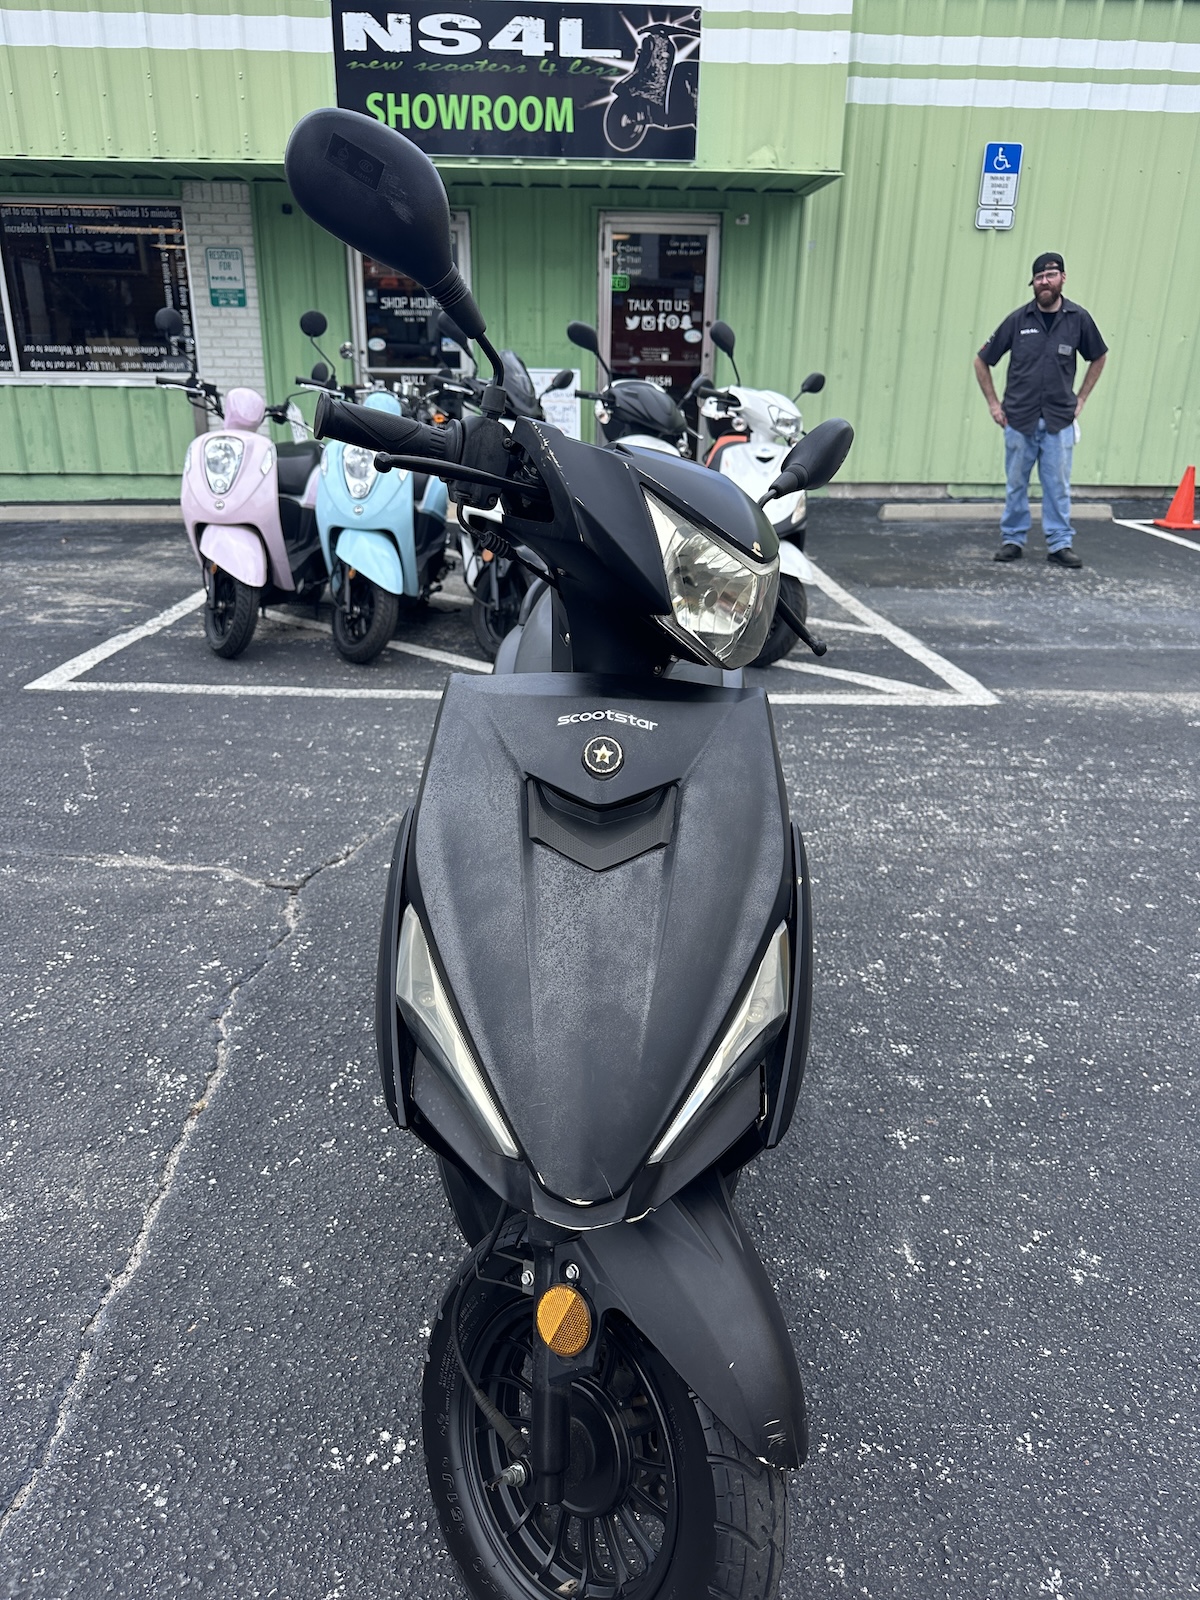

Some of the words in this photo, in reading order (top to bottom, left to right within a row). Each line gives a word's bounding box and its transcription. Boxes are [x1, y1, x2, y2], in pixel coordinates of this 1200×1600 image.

[342, 11, 622, 59] NS4L
[346, 58, 404, 71] new
[413, 58, 528, 75] scooters
[538, 59, 556, 77] 4
[566, 59, 622, 77] less
[366, 91, 574, 133] SHOWROOM
[12, 208, 20, 216] to
[379, 296, 409, 310] SHOP
[627, 299, 655, 313] TALK
[657, 299, 672, 312] TO
[674, 299, 691, 313] US
[557, 709, 659, 731] scootstar
